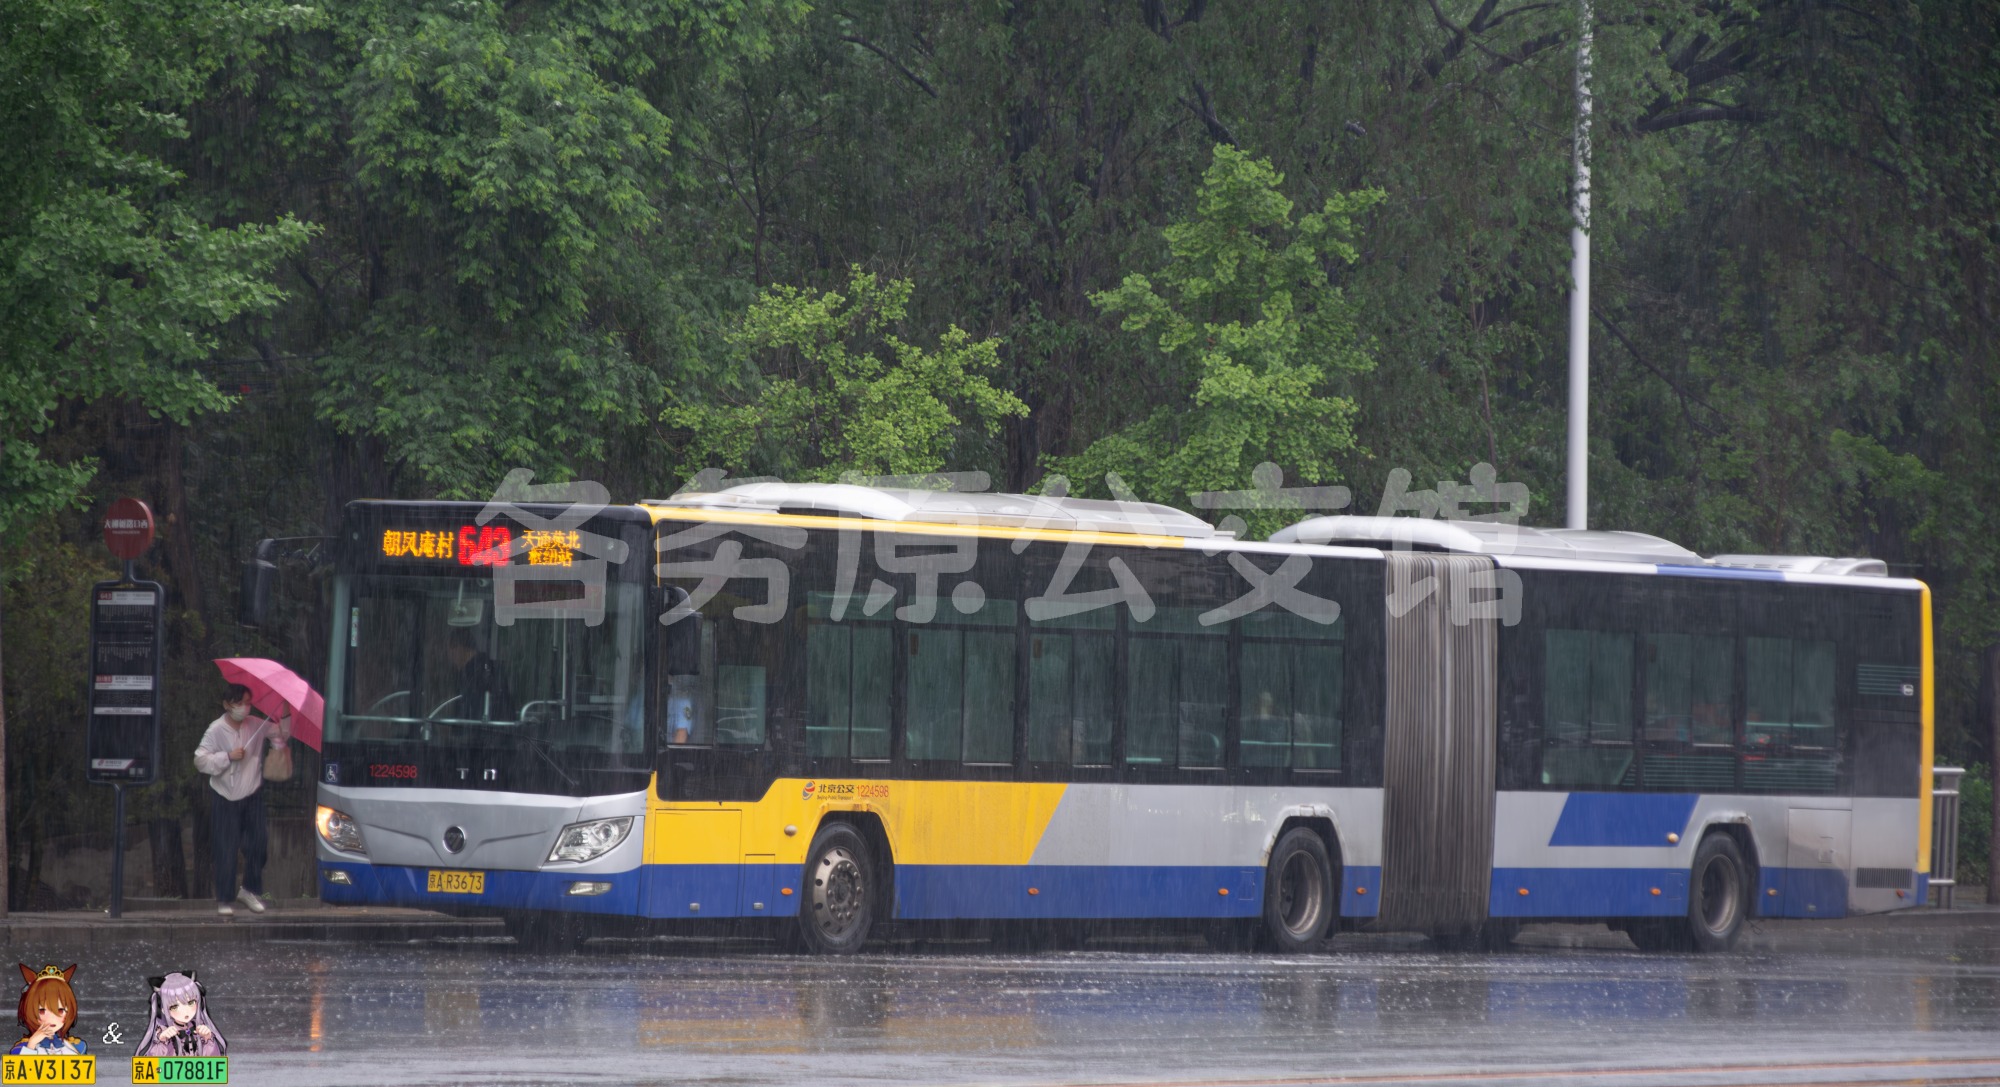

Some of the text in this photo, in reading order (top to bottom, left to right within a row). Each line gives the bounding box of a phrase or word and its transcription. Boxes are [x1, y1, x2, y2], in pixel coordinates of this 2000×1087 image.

[383, 529, 454, 558] 朝凤庵村
[458, 525, 512, 567] 643
[521, 530, 581, 549] 天通苑北
[369, 764, 418, 779] 1224598
[818, 784, 855, 794] 北京公交
[856, 785, 889, 798] 1224598
